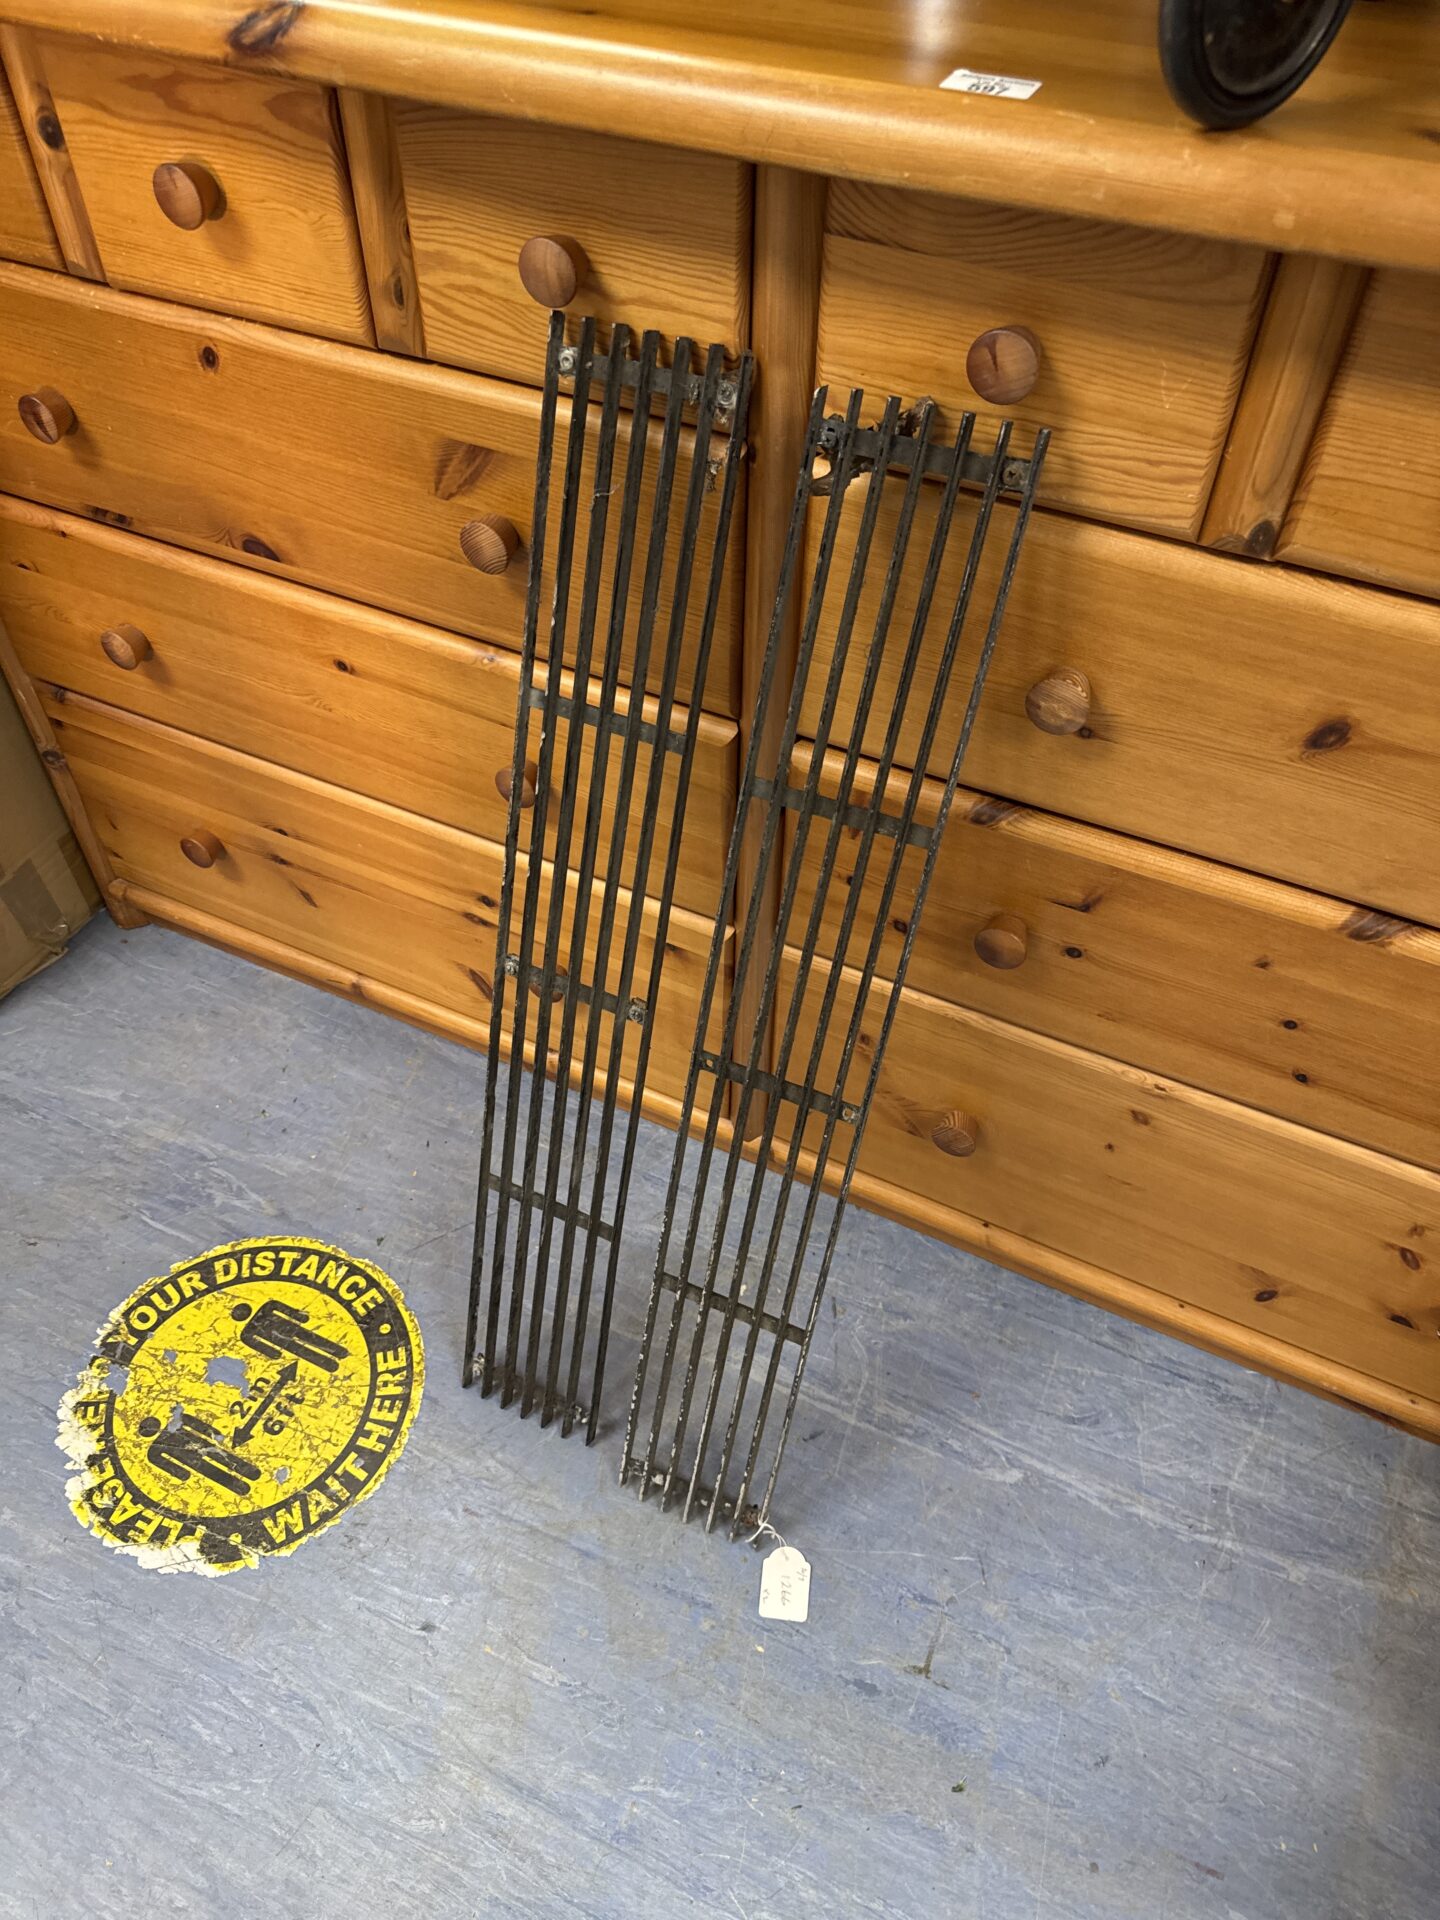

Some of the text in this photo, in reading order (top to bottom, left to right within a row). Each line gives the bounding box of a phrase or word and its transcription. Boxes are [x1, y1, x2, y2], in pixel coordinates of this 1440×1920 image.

[107, 1272, 209, 1347] YOUR
[214, 1251, 384, 1317] DISTANCE
[262, 1345, 408, 1543] WAIT HERE
[263, 1393, 305, 1436] 6ft
